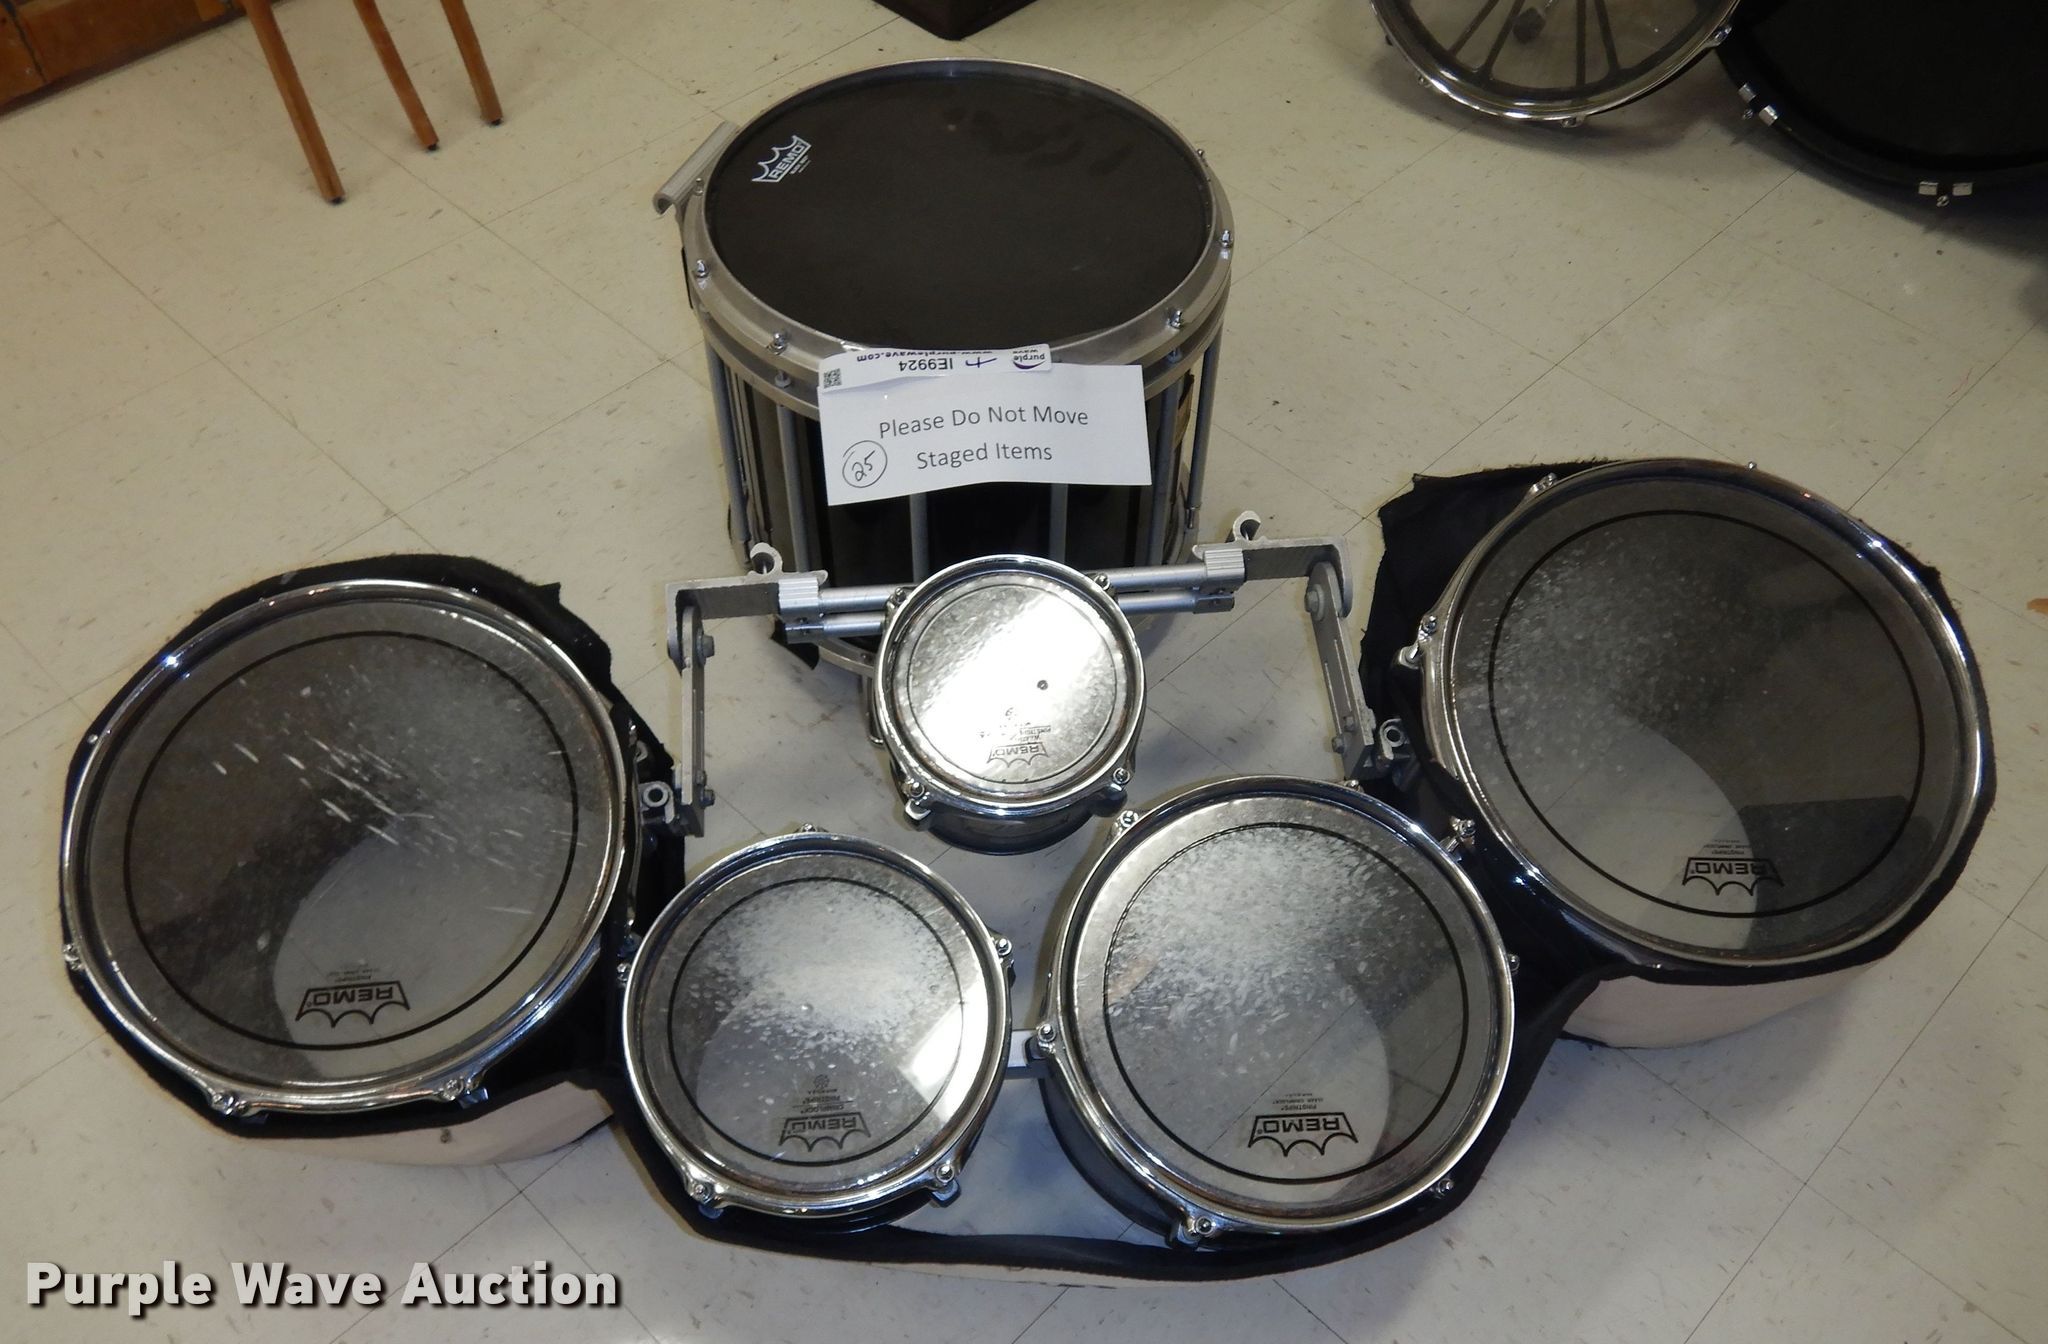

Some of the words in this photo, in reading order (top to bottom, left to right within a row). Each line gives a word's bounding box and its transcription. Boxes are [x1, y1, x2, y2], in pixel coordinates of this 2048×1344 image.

[767, 143, 806, 179] REMO
[898, 357, 954, 372] IE9924
[1013, 353, 1046, 363] purple
[879, 413, 944, 439] Please
[952, 409, 981, 427] Do
[988, 406, 1027, 423] Not
[1033, 406, 1089, 425] Move
[916, 442, 988, 470] Staged
[996, 442, 1053, 461] Items
[851, 449, 877, 482] 25
[993, 745, 1040, 757] REMO
[1693, 862, 1768, 875] REMO
[311, 986, 394, 1006] REMO
[790, 1117, 857, 1134] REMO
[1261, 1117, 1341, 1134] REMO
